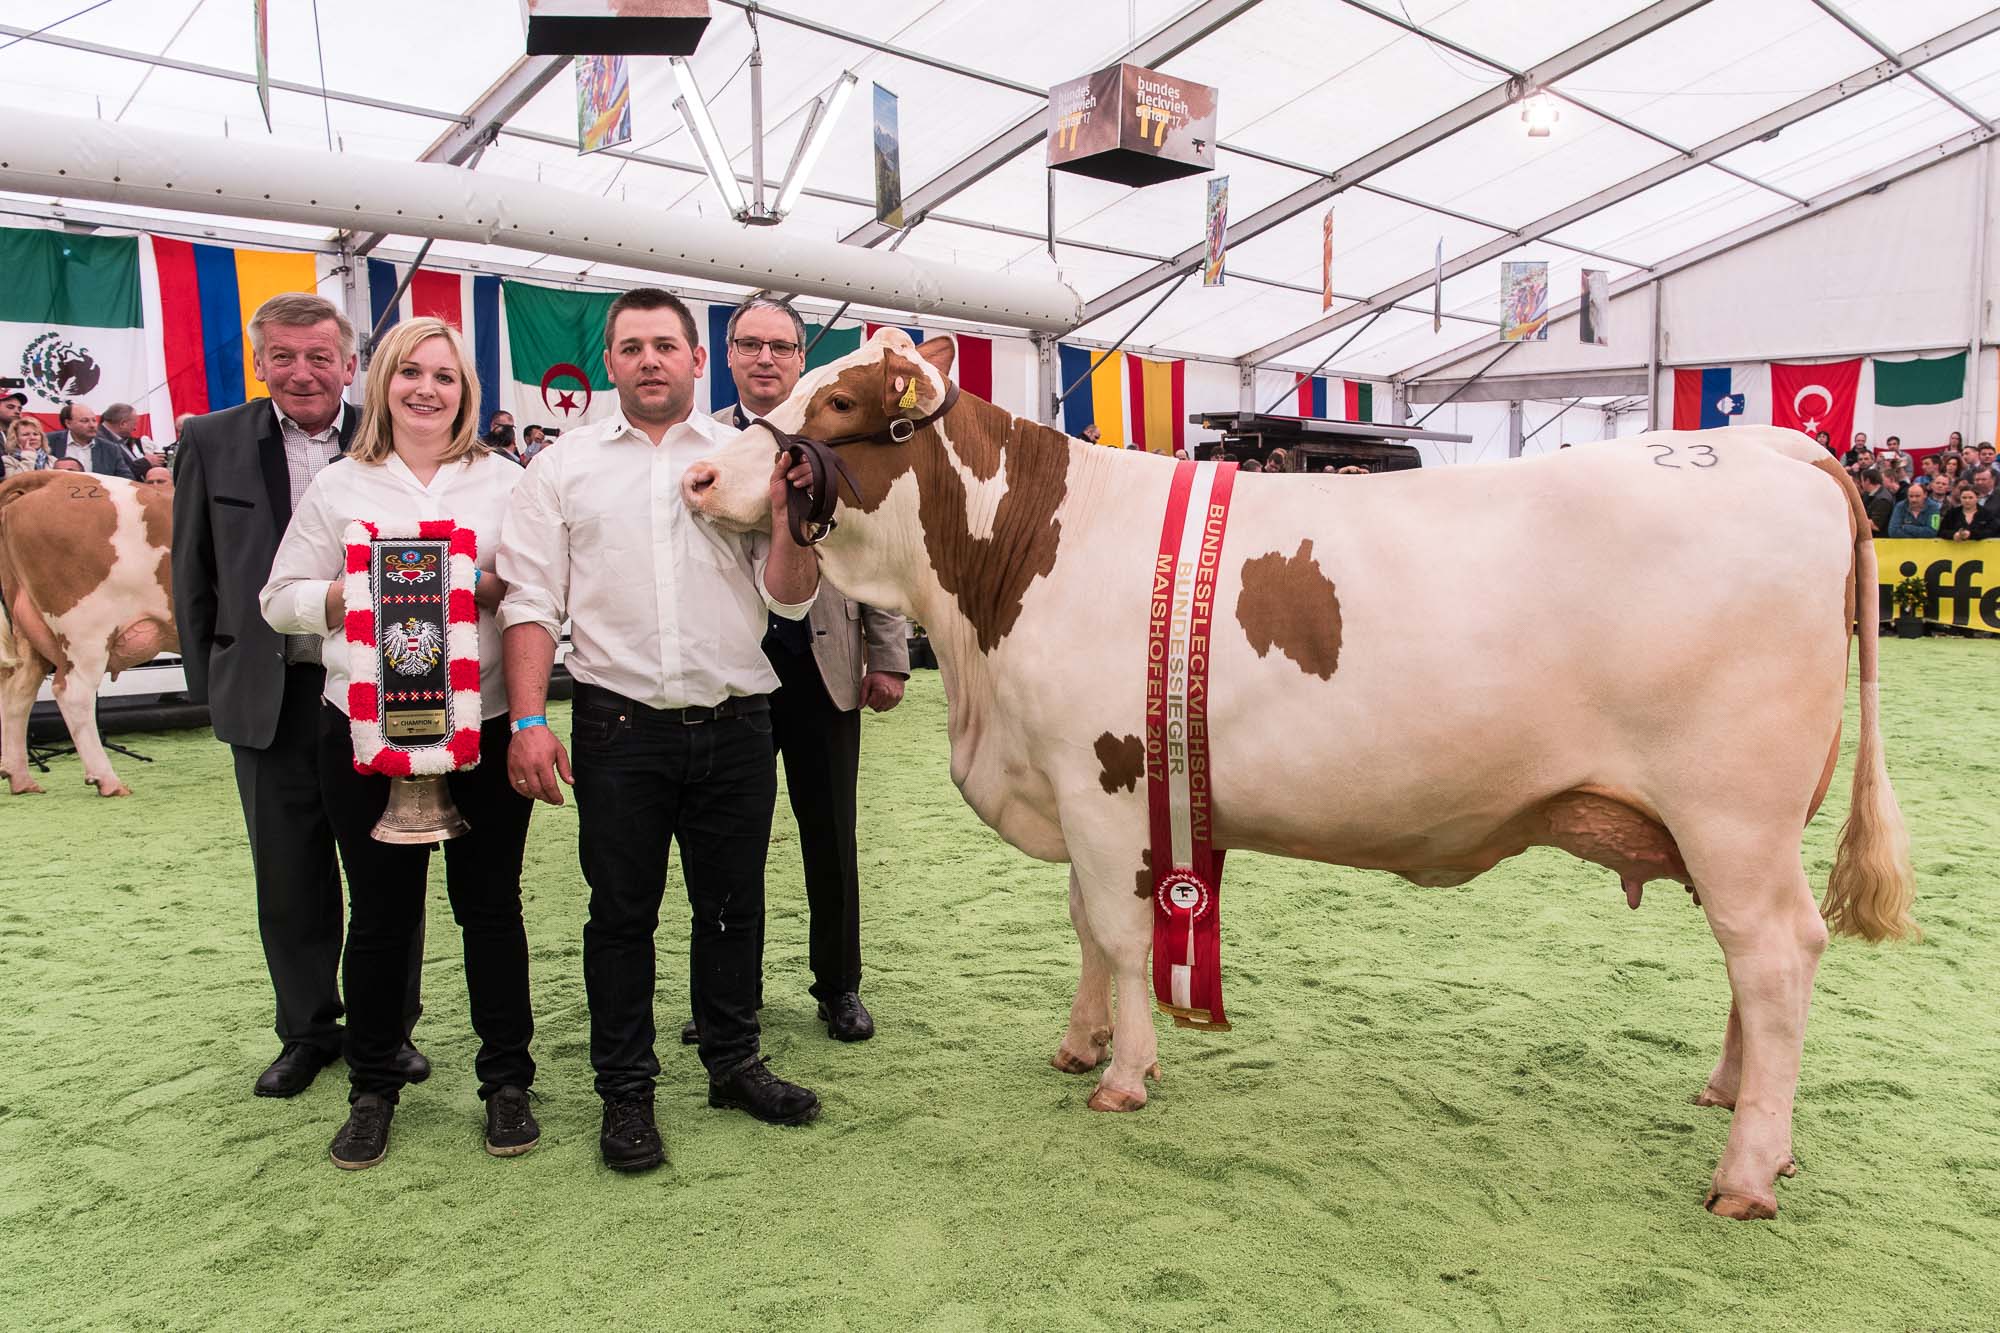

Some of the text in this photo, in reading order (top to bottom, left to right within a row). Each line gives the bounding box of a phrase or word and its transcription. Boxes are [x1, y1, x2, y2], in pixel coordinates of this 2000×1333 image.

[1137, 76, 1180, 99] bundes
[1136, 90, 1189, 116] fleckvieh
[1647, 444, 1719, 468] 23
[68, 485, 103, 499] 22
[1147, 553, 1174, 783] MAISHOFEN 2017
[1168, 561, 1194, 776] BUNDESSIEGER
[1188, 503, 1225, 842] BUNDESFLECKVIEHSCHAU
